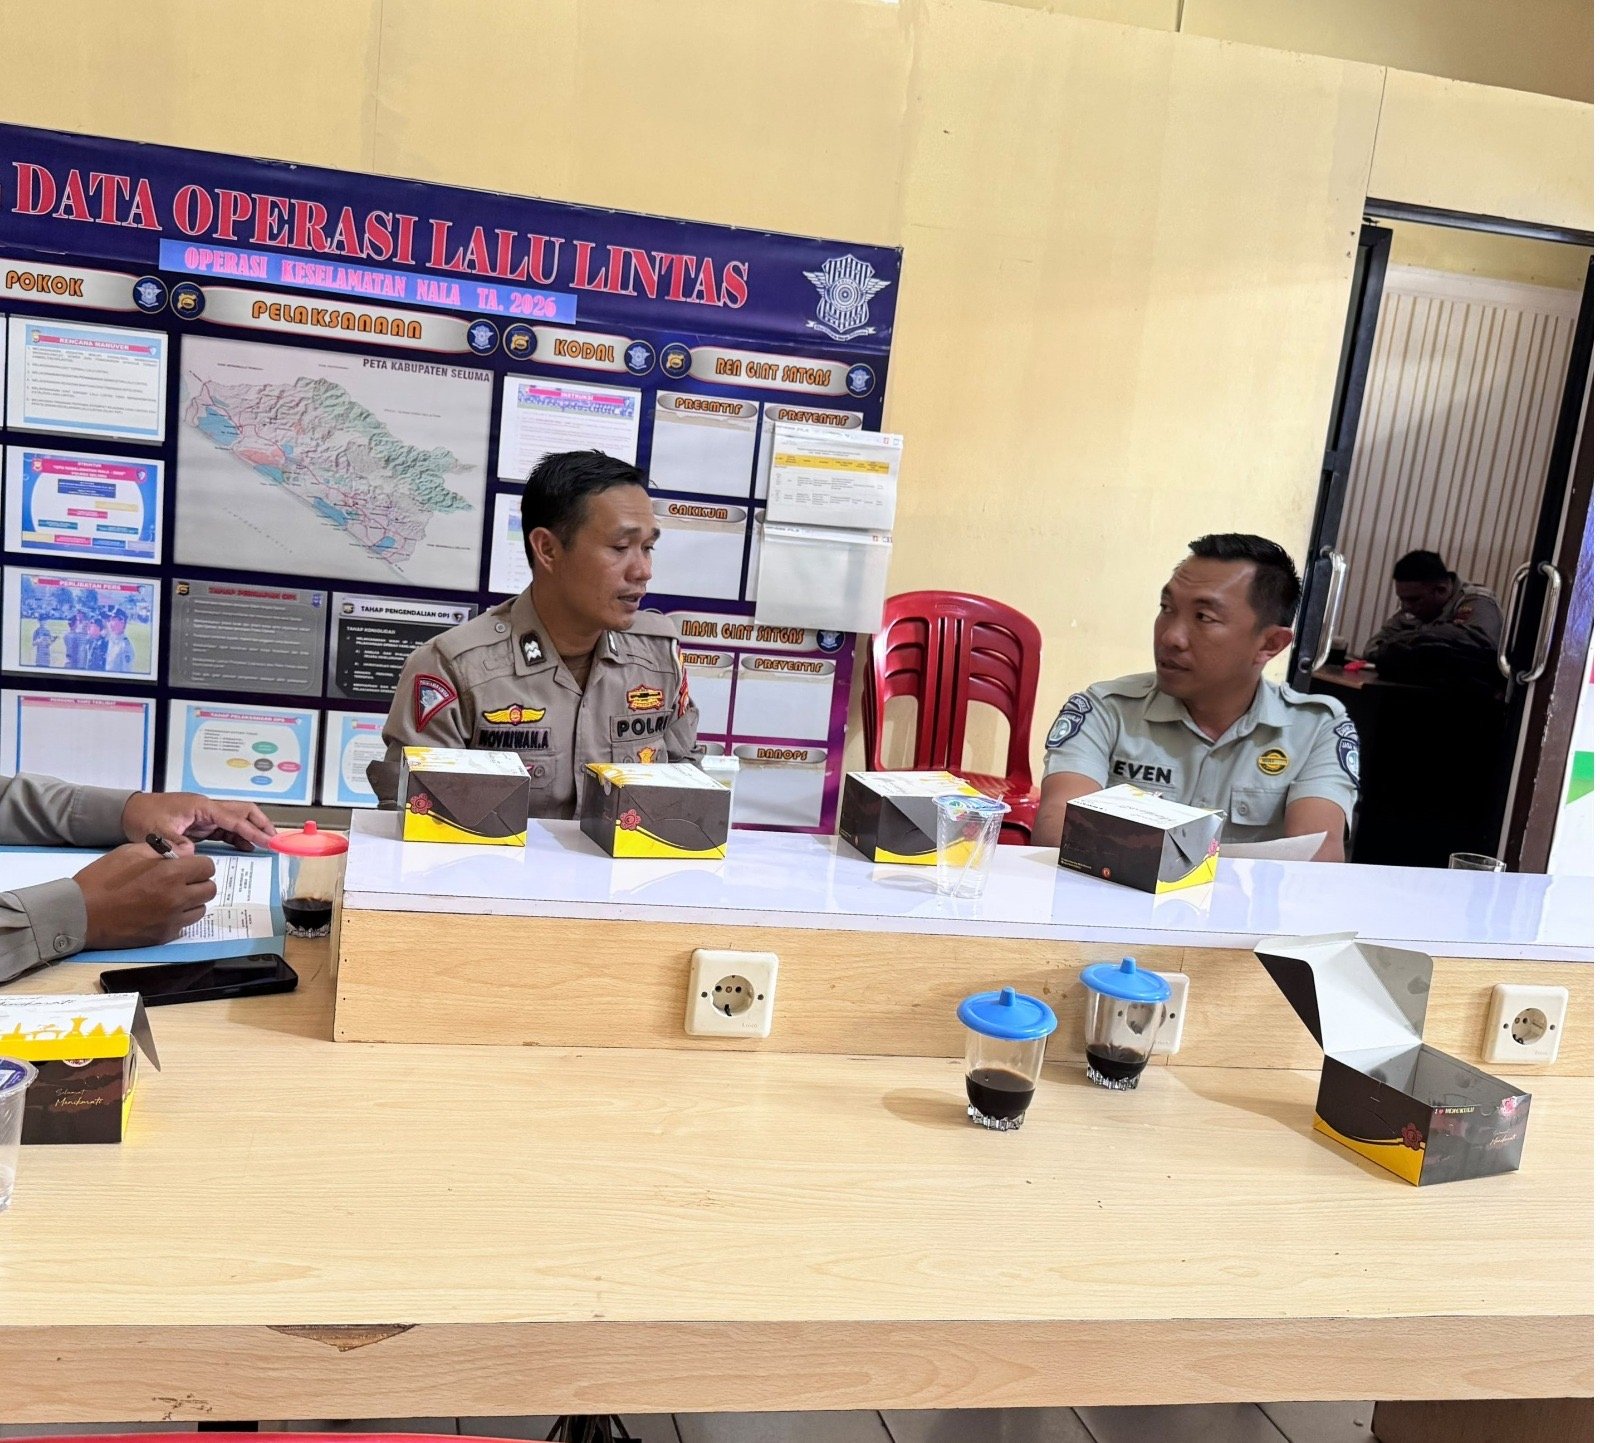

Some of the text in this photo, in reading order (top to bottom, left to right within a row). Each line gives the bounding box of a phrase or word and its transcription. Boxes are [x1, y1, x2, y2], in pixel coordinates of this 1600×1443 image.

[12, 162, 749, 309] DATA OPERASI LALU LINTAS
[6, 270, 84, 297] POKOK
[184, 247, 557, 317] OPERASI KESELAMATAN NALA TA. 2026
[252, 301, 422, 339] PELAKSANAAN
[553, 338, 615, 364] KODAL
[363, 358, 388, 370] PETA
[391, 362, 448, 377] KABUPATEN
[451, 368, 490, 382] SELUMA
[715, 358, 831, 387] REN GIAT SATGAS
[675, 397, 743, 415] PREEMTIF
[778, 409, 850, 427] PREVENTIF
[669, 504, 728, 520] GAKKUM
[385, 608, 437, 617] PENGENDALIAN
[682, 620, 804, 644] HASIL GIAT SATGAS
[755, 658, 823, 673] PREVENTIF
[617, 715, 669, 738] POLRI
[757, 748, 808, 761] BANOPS
[1113, 760, 1172, 784] EVEN
